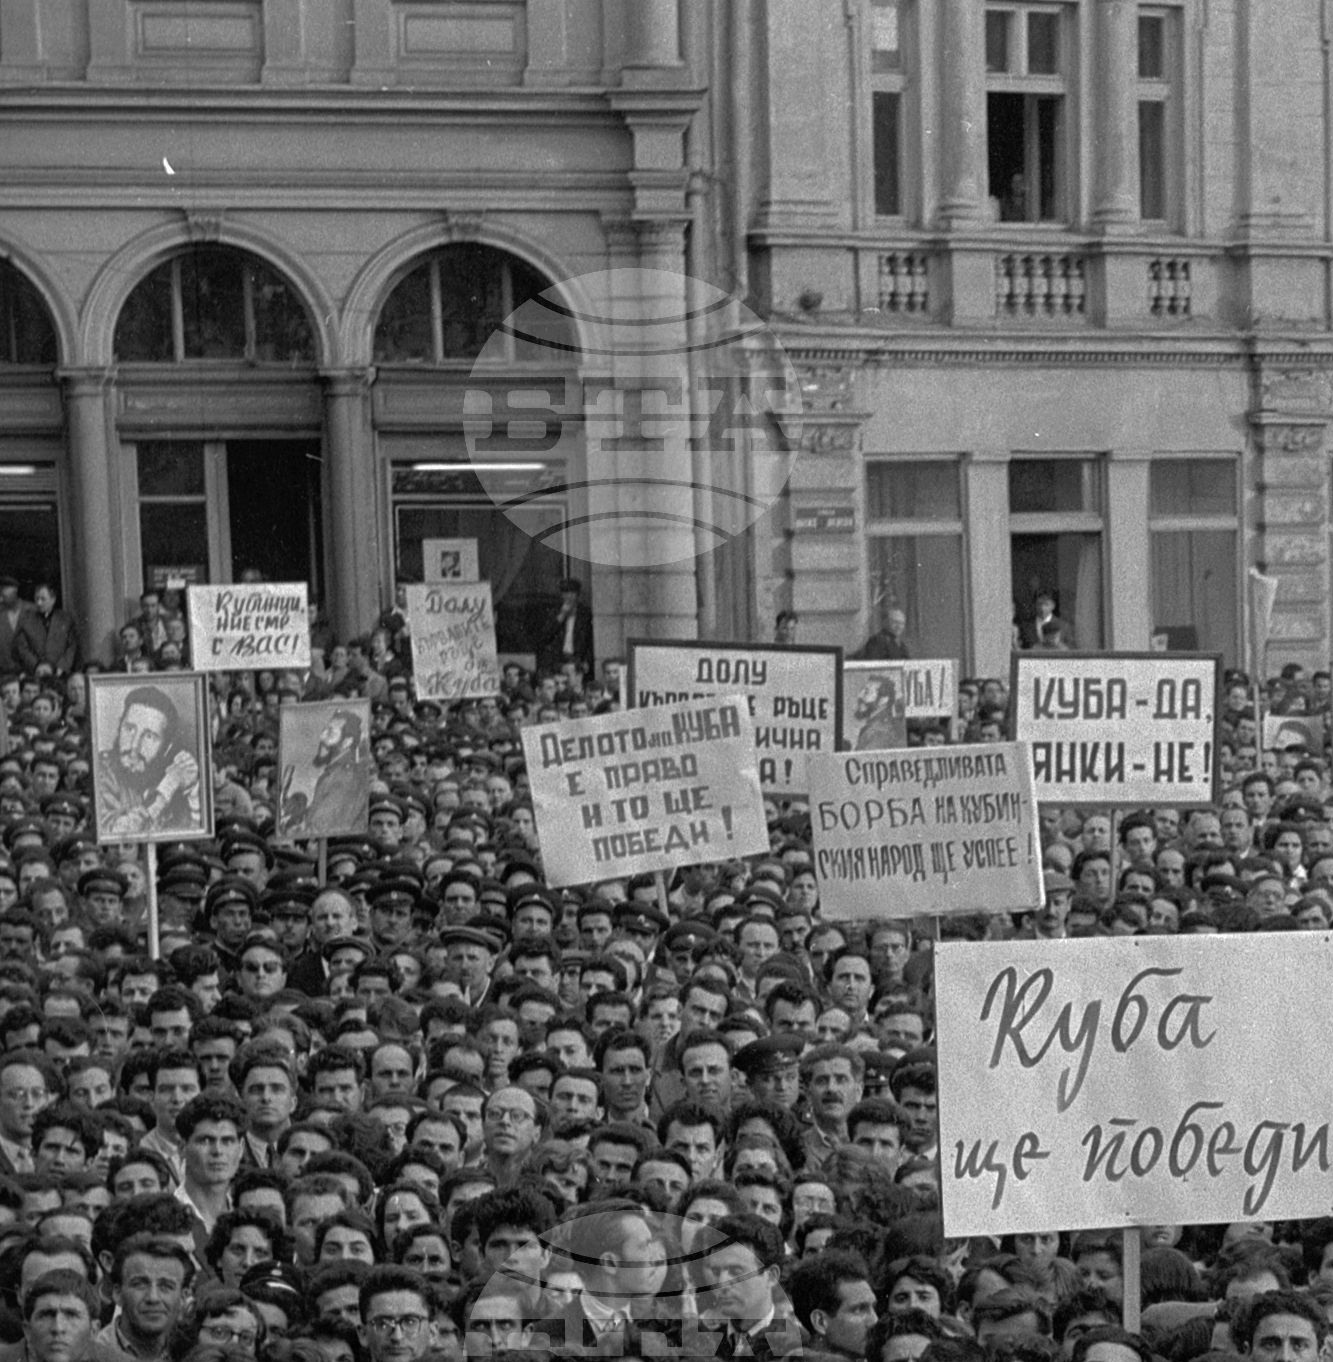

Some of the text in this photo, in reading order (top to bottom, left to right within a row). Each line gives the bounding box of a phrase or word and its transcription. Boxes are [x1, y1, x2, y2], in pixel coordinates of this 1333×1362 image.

[695, 657, 767, 686] ДОЛУ
[671, 705, 741, 744] КУБА
[604, 753, 699, 789] ПРАВО
[611, 795, 649, 823] ТО
[662, 785, 714, 815] ЩЕ
[818, 797, 925, 831] БОРБА
[868, 842, 926, 884] НАРОД
[929, 840, 957, 885] ЩЕ
[979, 965, 1218, 1114] Куба
[954, 1130, 1052, 1211] ще
